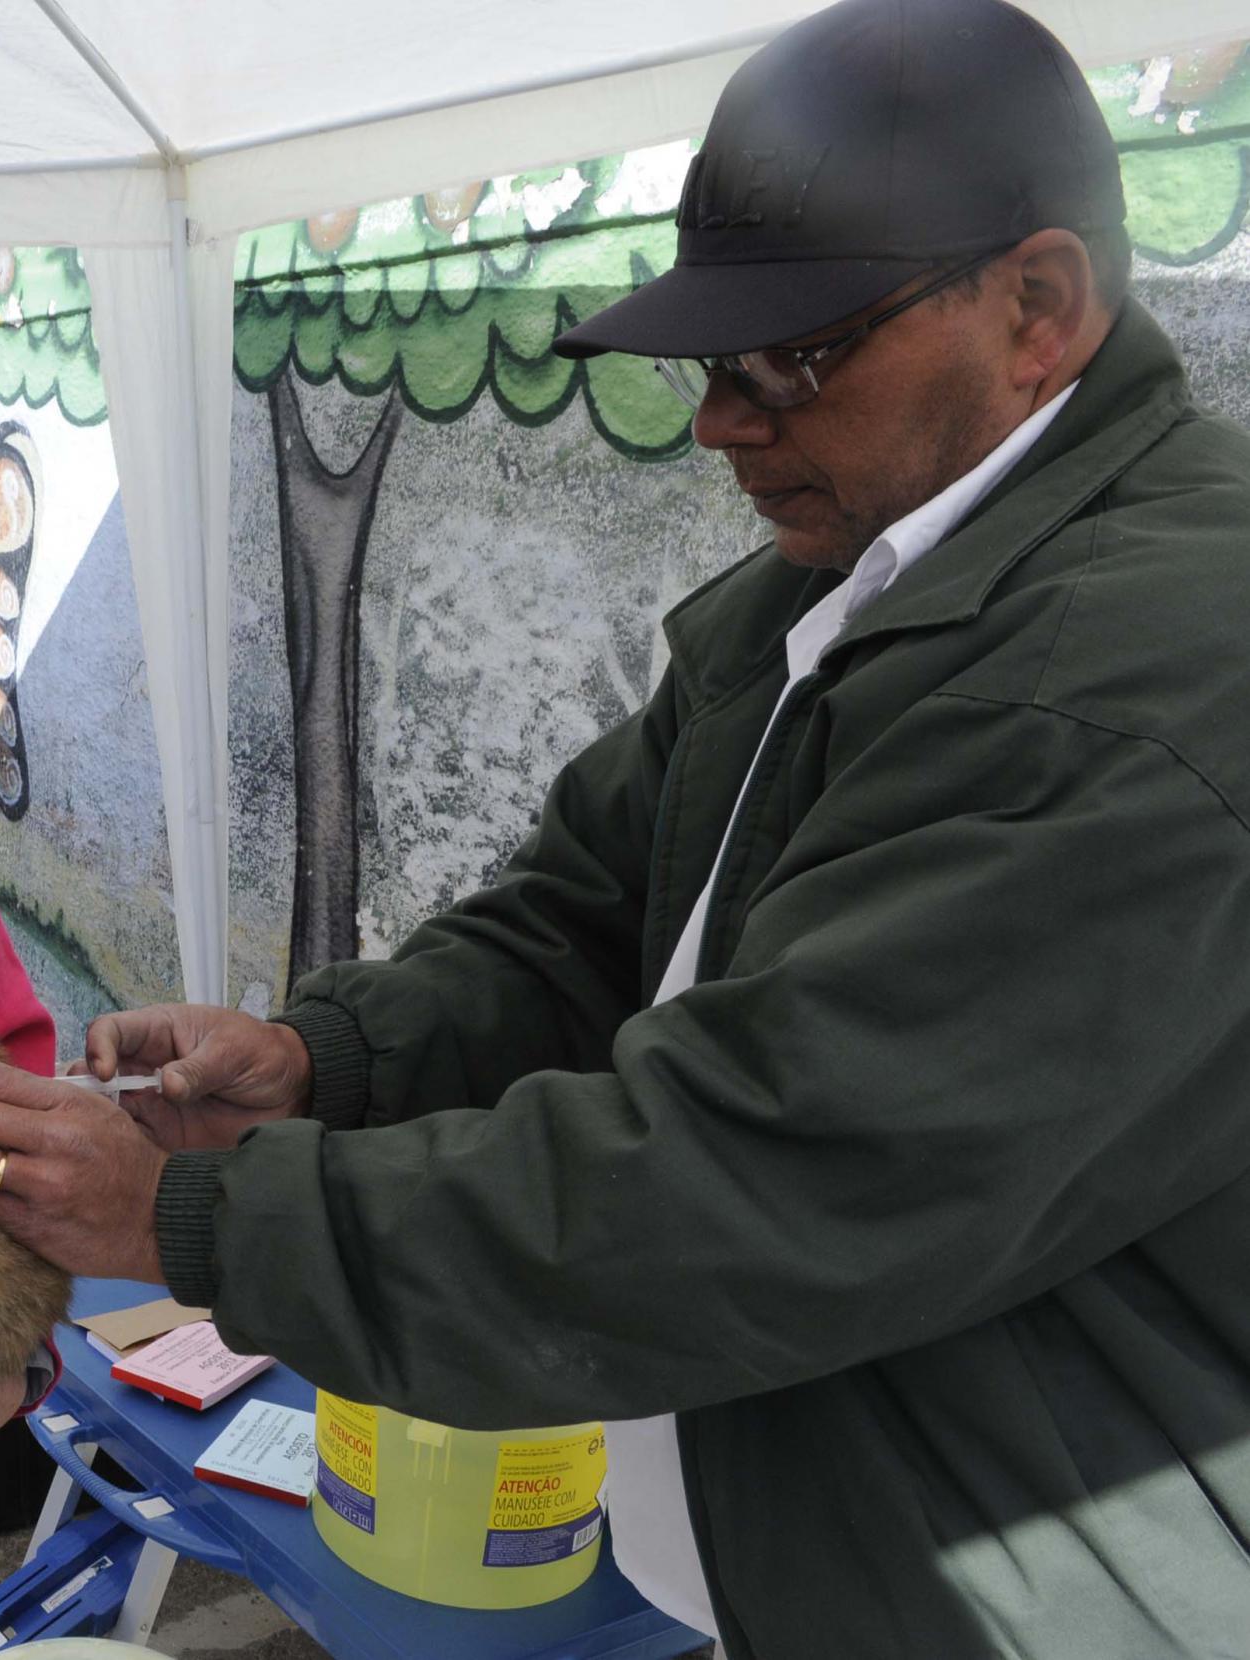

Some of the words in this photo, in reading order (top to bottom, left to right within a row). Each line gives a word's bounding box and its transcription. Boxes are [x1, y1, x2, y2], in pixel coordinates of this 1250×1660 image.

[282, 1432, 310, 1461] AGOSTO
[335, 1460, 372, 1492] CUIDADO
[352, 1454, 371, 1476] CON
[498, 1475, 562, 1497] ATENÇÃO
[494, 1495, 554, 1512] MANUSEIE
[554, 1489, 577, 1508] COM
[493, 1511, 546, 1528] CUIDADO
